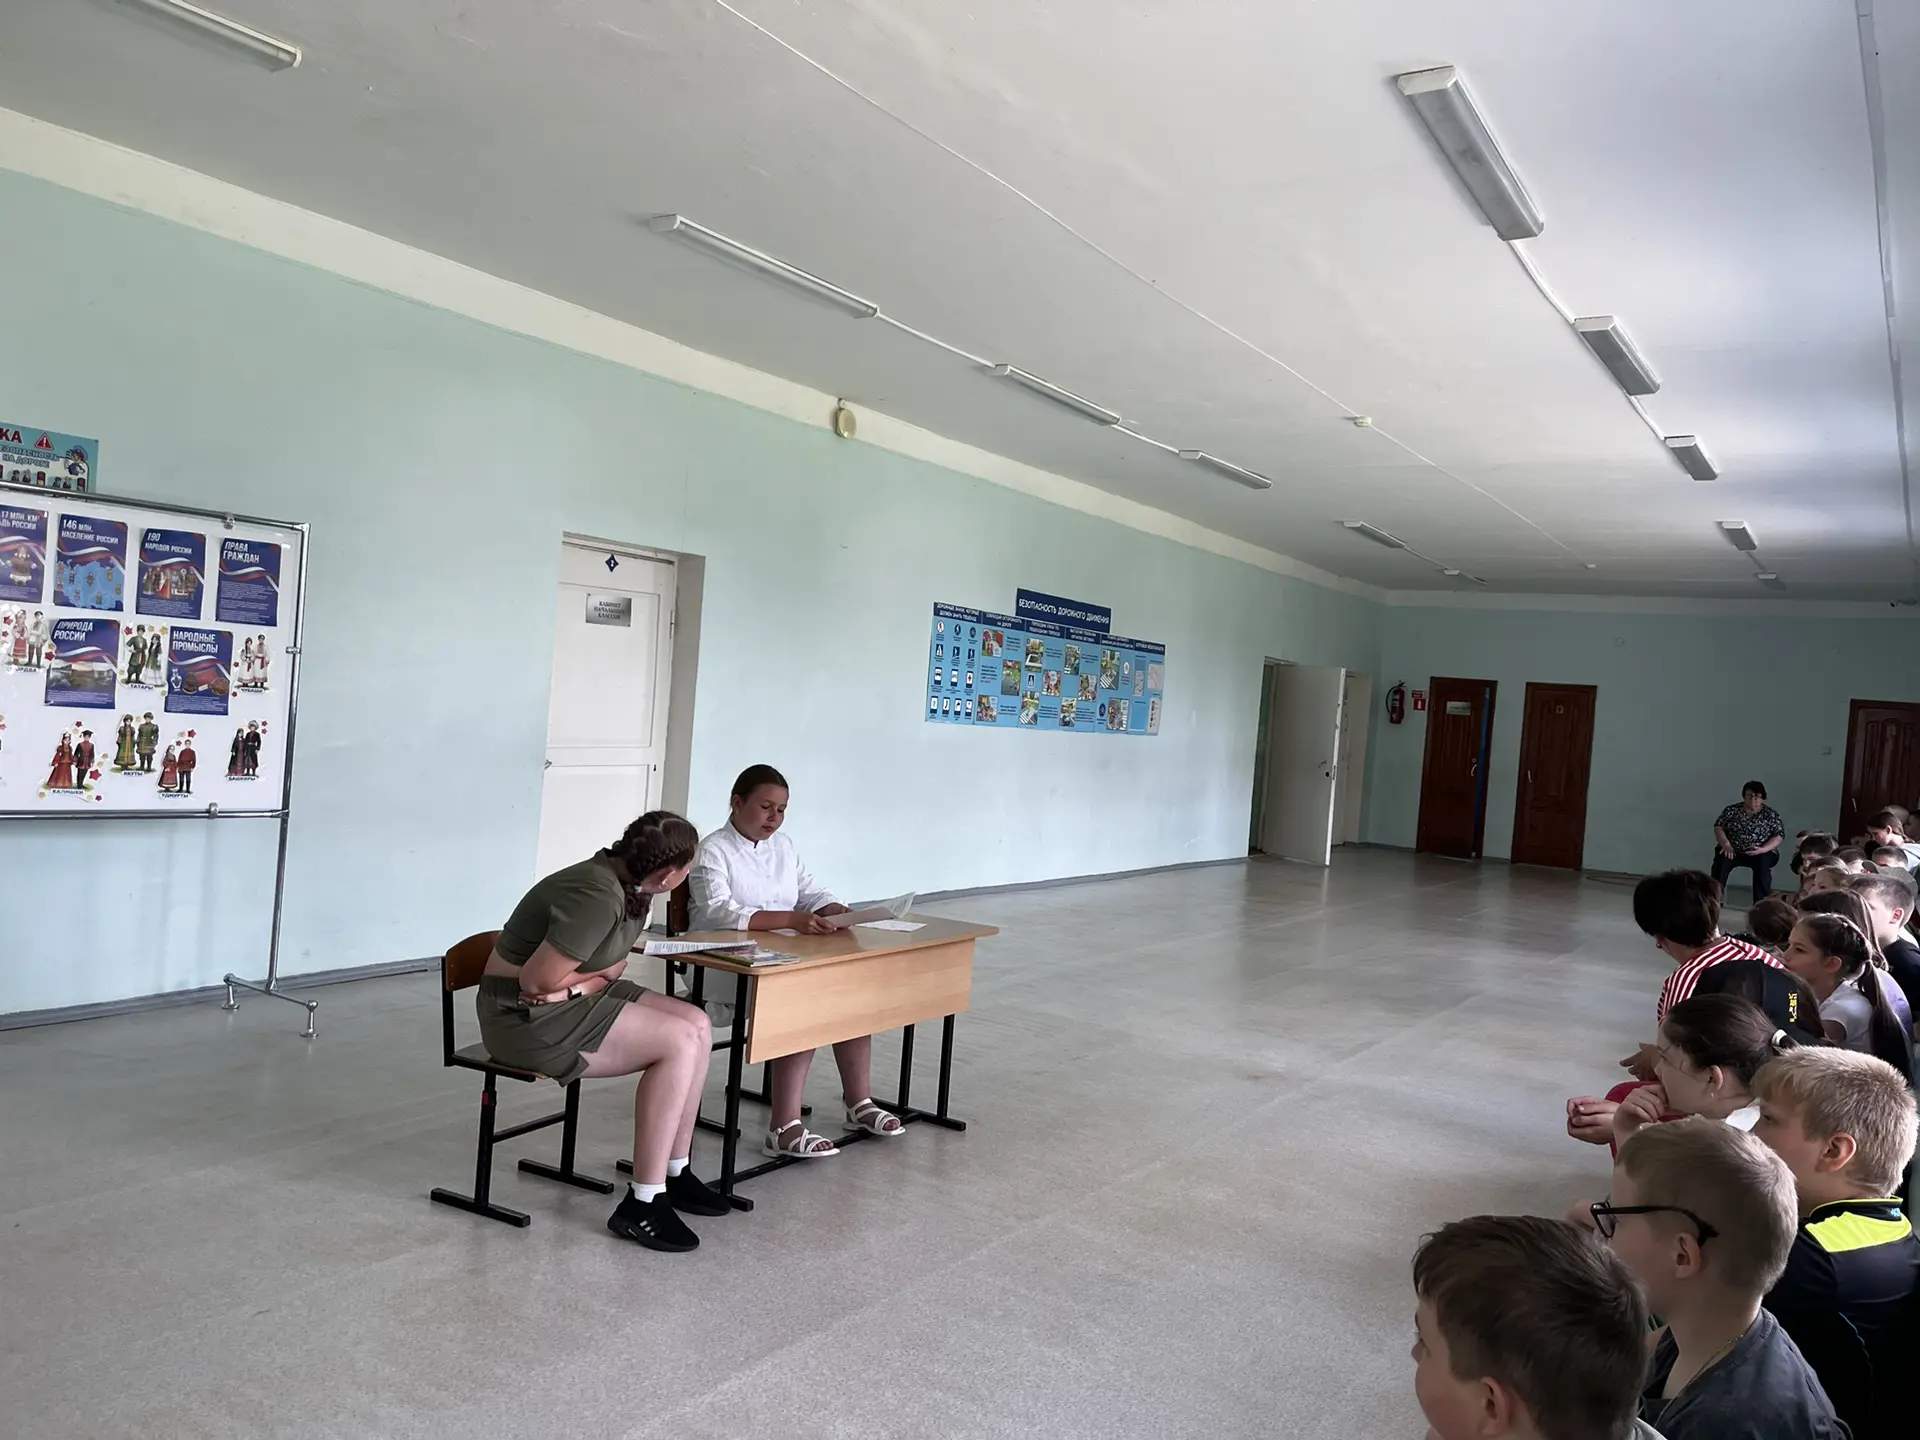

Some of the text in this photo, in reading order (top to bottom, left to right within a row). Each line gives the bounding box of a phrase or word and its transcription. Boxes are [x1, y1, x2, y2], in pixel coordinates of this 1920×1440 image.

[1, 511, 9, 519] 17
[11, 520, 37, 530] РОССИИ
[63, 519, 77, 529] 146
[61, 530, 119, 545] НАСЕЛЕНИЕ РОССИИ
[147, 532, 161, 541] 190
[144, 543, 193, 554] НАРОДОВ РОССИИ
[224, 541, 249, 552] ПРАВА
[222, 550, 260, 563] ГРАЖДАН
[1018, 598, 1110, 624] БЕЗОПАСНОСТЬ ДОРОЖНОГО ДВИЖЕНИЯ
[57, 620, 93, 632] ПРИРОДА
[53, 630, 86, 641] РОССИИ
[173, 630, 216, 644] НАРОДНЫЕ
[172, 641, 219, 653] ПРОМЫСЛЫ
[52, 788, 84, 796] КАЛМЫКИ
